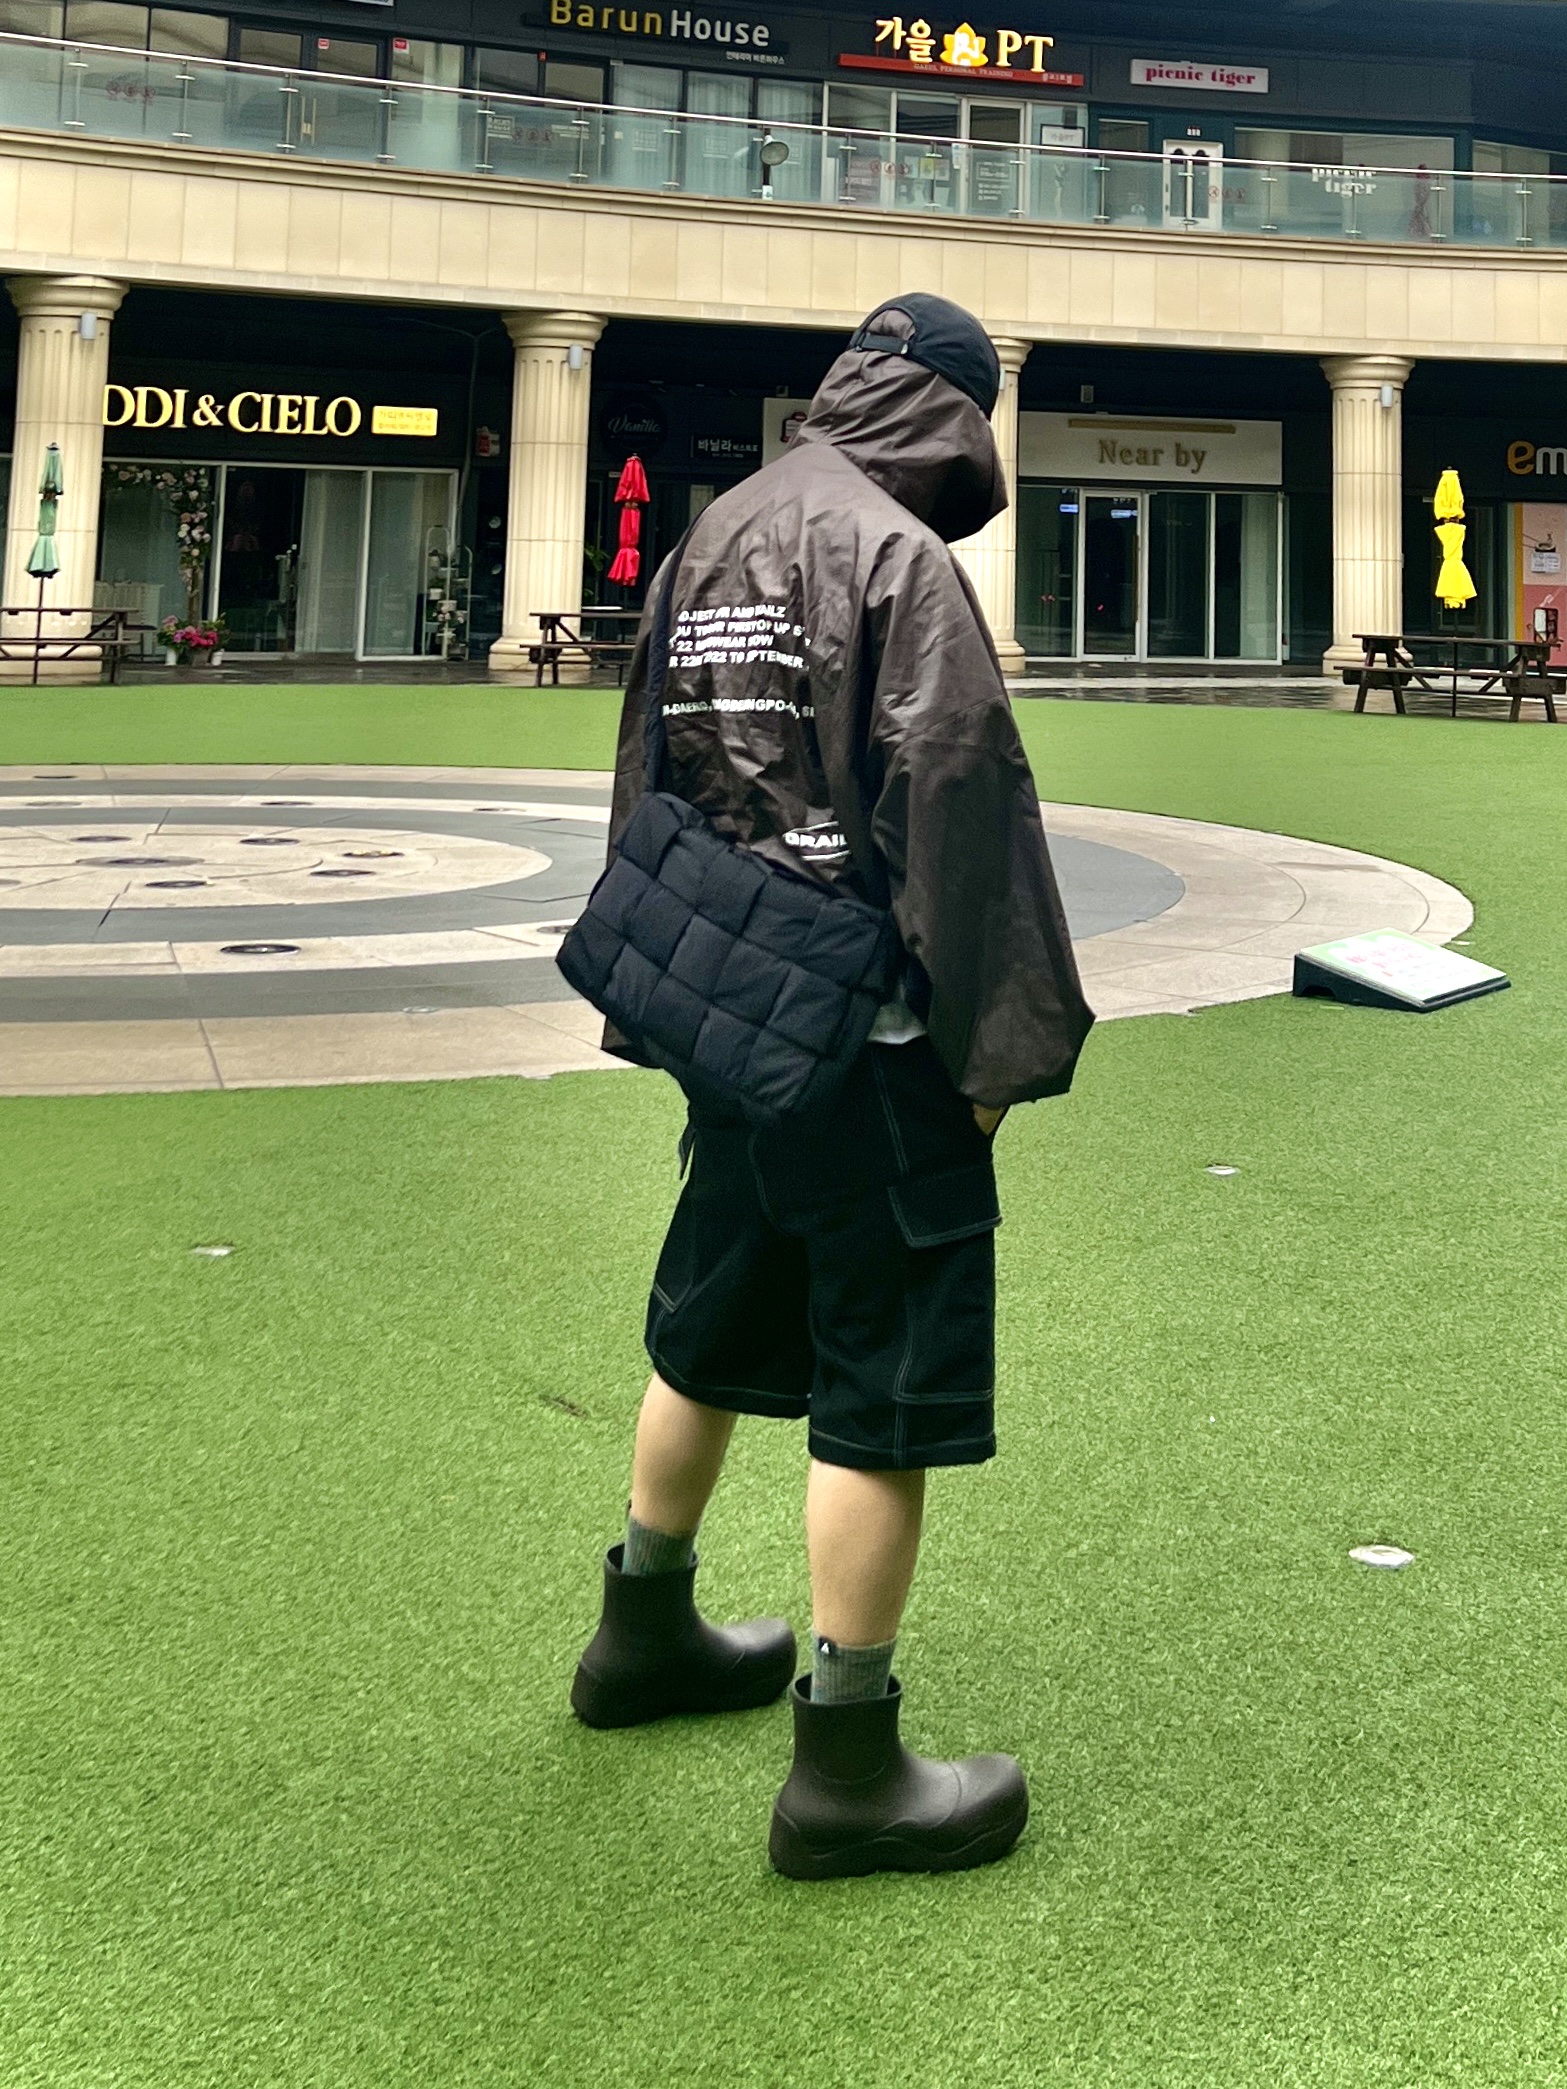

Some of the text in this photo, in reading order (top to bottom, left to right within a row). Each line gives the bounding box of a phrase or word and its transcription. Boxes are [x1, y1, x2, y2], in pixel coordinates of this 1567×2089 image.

[875, 17, 1054, 73] 가을 PT
[1145, 63, 1256, 87] picnic tiger
[227, 391, 362, 437] CIELO
[698, 438, 732, 452] 바닐라
[1098, 439, 1207, 474] Near by
